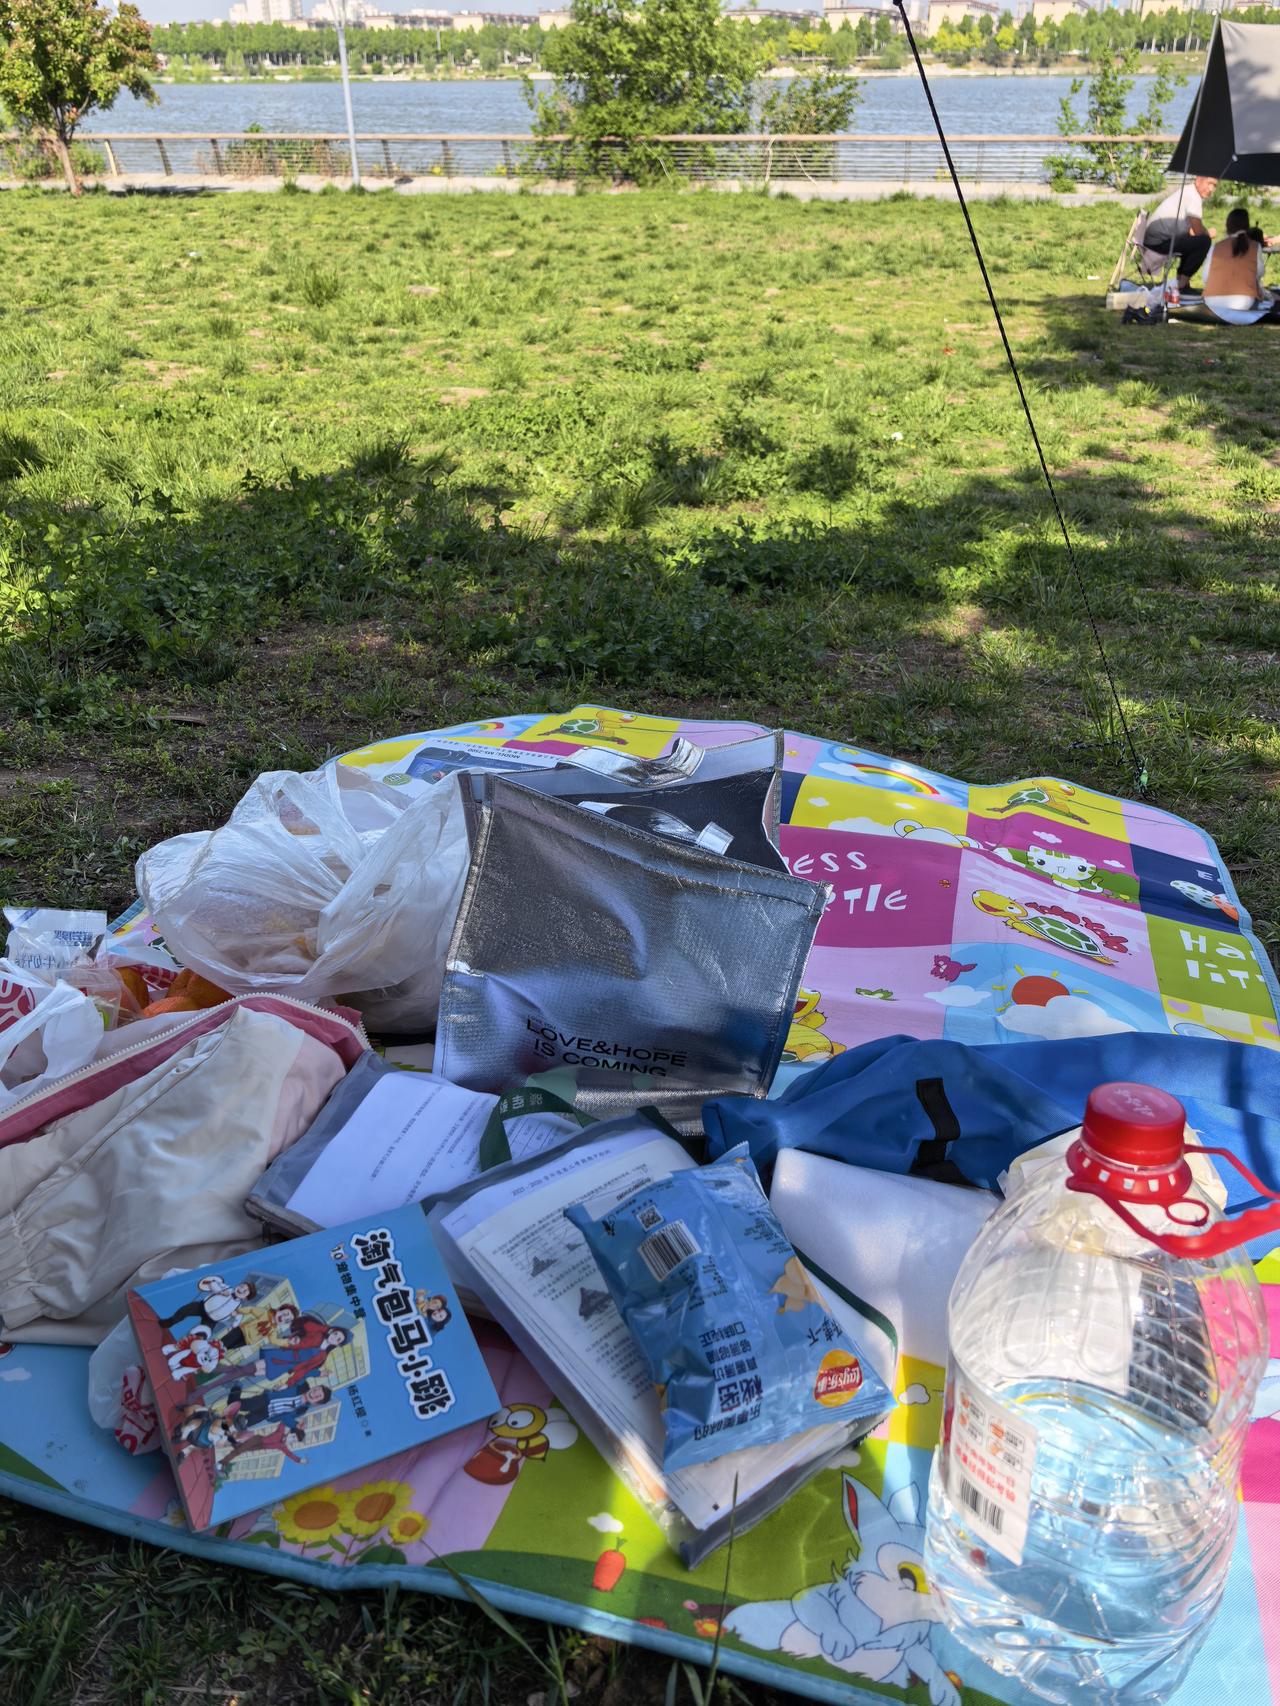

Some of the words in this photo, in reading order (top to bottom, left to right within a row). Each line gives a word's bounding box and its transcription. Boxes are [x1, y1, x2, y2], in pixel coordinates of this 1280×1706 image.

[526, 1018, 688, 1068] LOVE&HOPE
[534, 1038, 556, 1057] IS
[562, 1051, 667, 1078] COMING
[353, 1230, 453, 1416] 淘气包马小跳
[700, 1321, 745, 1347] 口味纯正
[717, 1374, 764, 1414] 秘密
[693, 1402, 762, 1441] 乐事美味的
